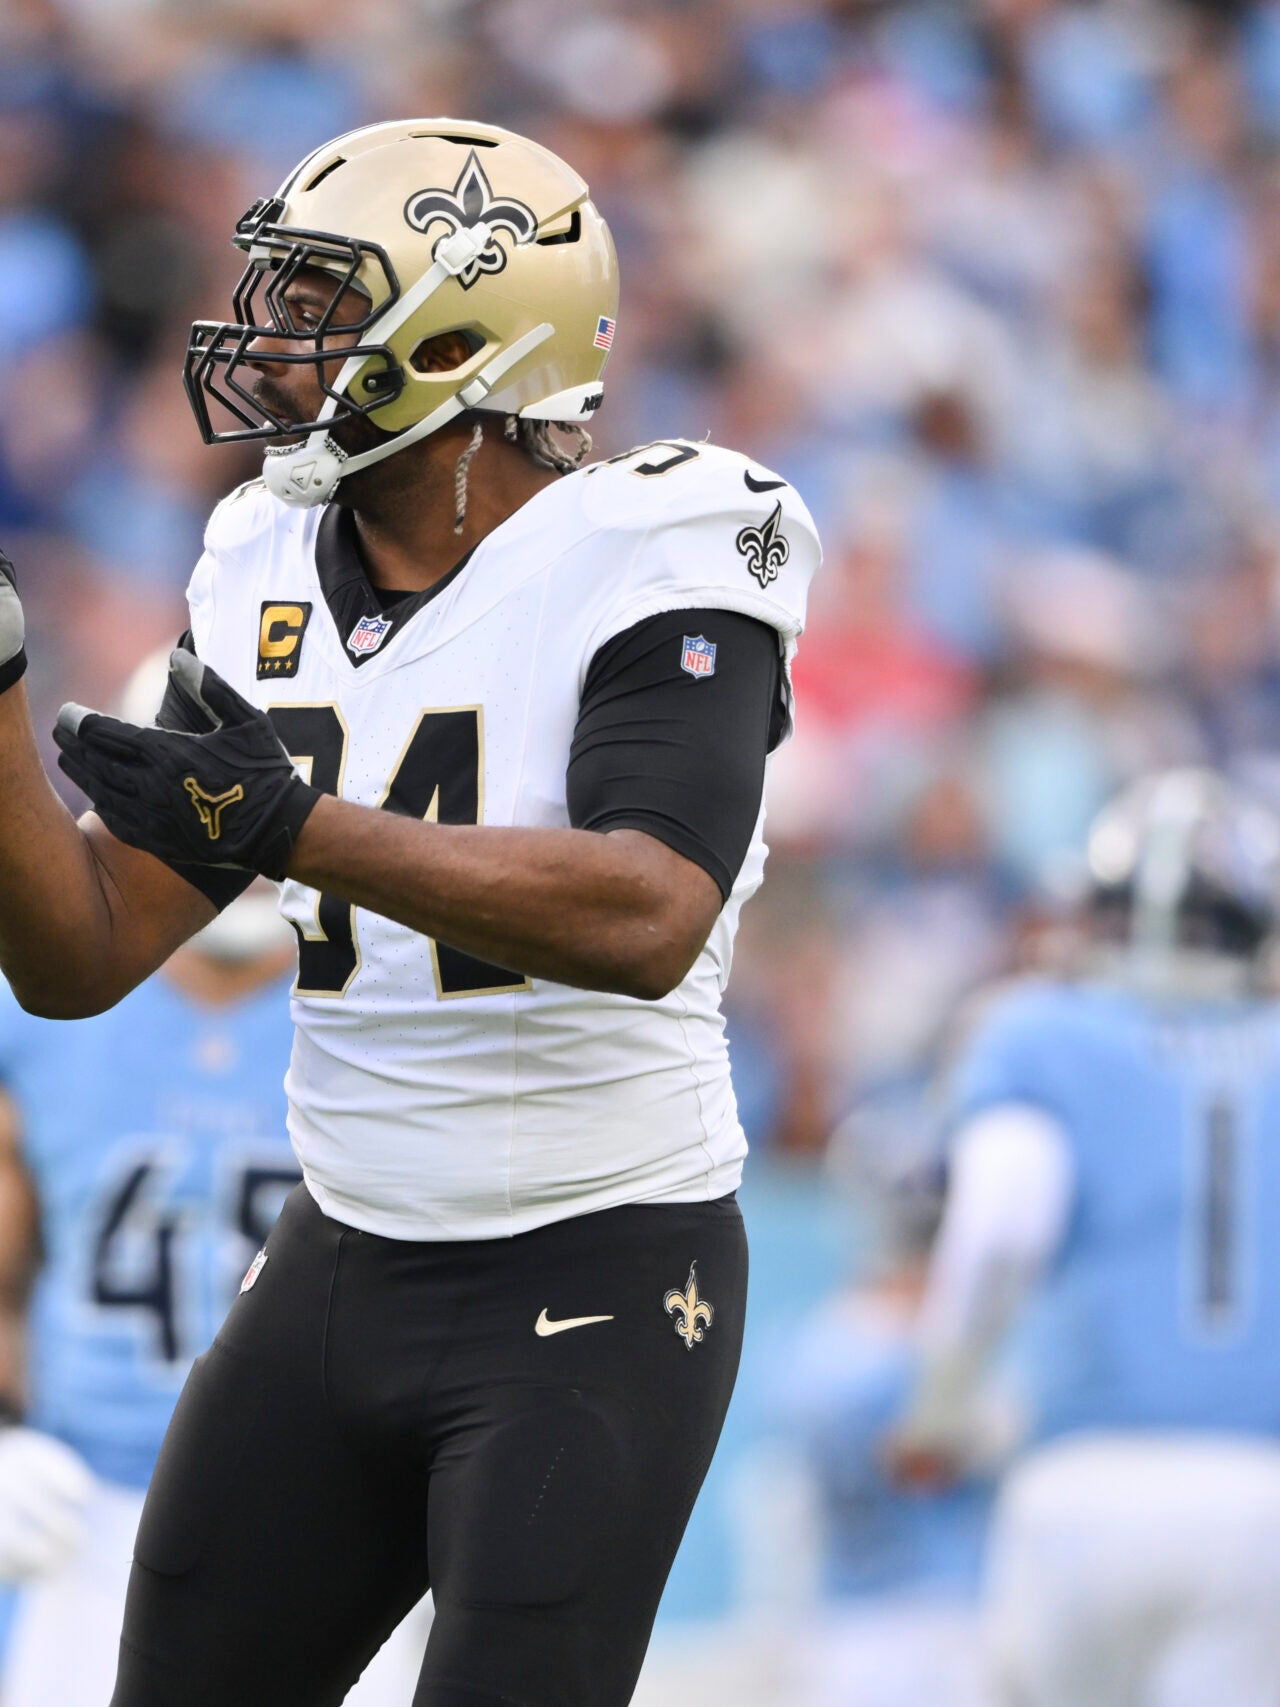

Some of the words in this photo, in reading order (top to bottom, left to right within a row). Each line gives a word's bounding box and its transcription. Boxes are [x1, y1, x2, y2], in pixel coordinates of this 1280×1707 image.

[260, 606, 304, 658] C
[353, 630, 375, 649] NFL
[685, 651, 711, 673] NFL
